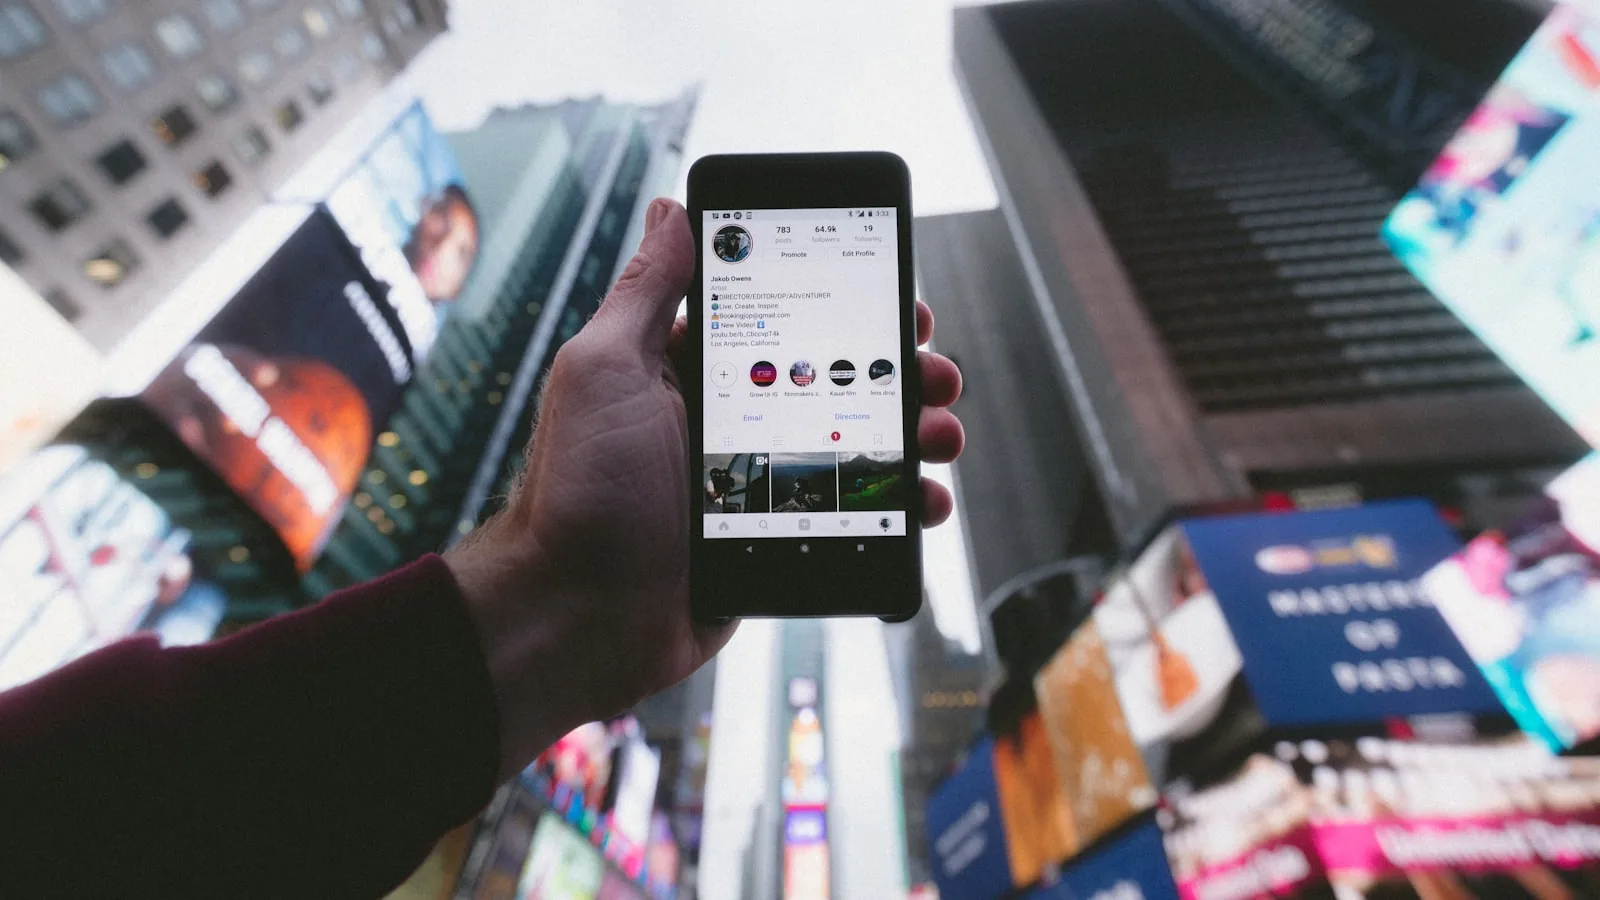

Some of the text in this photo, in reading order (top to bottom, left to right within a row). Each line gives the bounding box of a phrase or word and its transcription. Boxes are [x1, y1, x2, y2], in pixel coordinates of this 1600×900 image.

[776, 226, 791, 234] 783
[775, 237, 792, 245] posts
[854, 235, 883, 243] following
[719, 292, 831, 300] DIRECTOR/EDITOR/DP/ADVENTURER
[743, 414, 763, 422] Email
